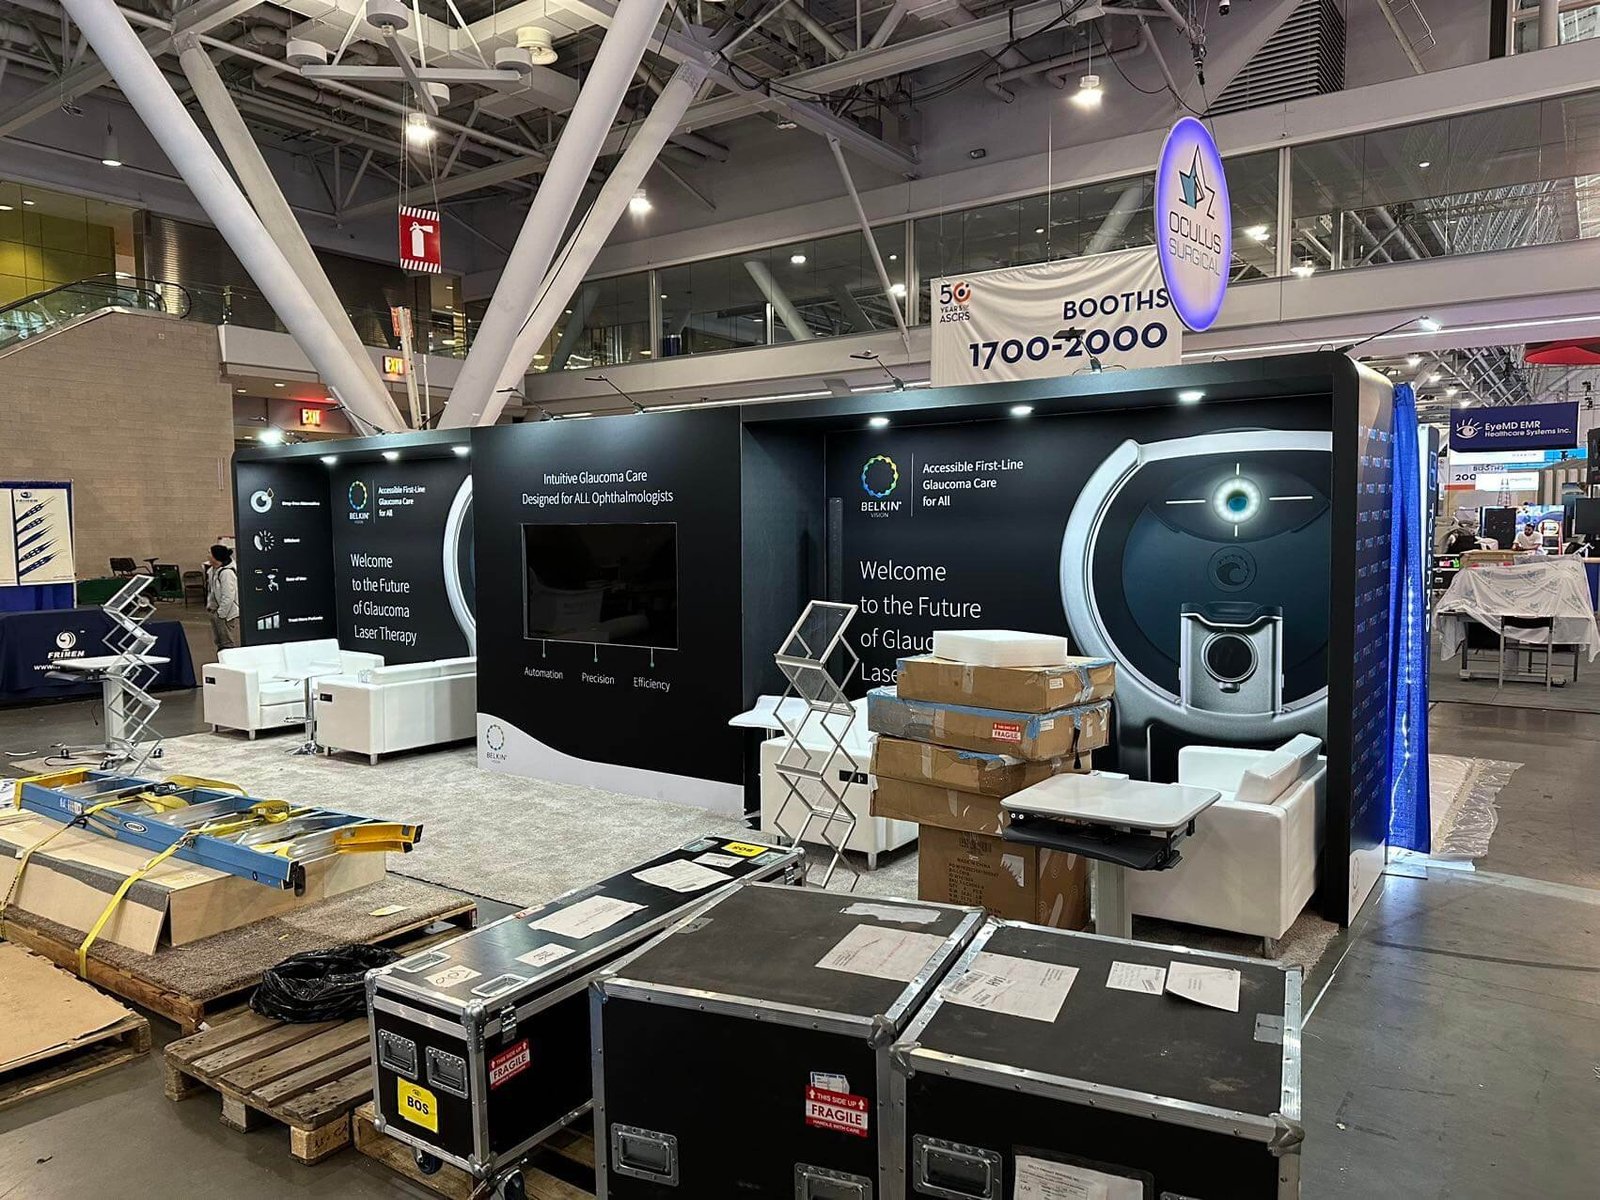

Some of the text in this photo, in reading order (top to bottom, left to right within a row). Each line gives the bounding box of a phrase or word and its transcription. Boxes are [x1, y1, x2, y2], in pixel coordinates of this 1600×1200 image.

[1169, 211, 1221, 255] OCULUS
[1169, 236, 1221, 277] SURGICAL
[1063, 288, 1169, 320] BOOTHS
[940, 311, 971, 323] ASCRS
[969, 322, 1168, 370] 1700-2000
[385, 356, 403, 374] EXIT
[302, 408, 320, 425] EXIT
[1484, 420, 1541, 431] EyeMD EMR
[1526, 428, 1556, 436] Systems
[922, 458, 1024, 474] Accessible First-Line
[543, 469, 648, 485] Intuitive Glaucoma Care
[922, 477, 997, 490] Glaucoma Care
[378, 484, 426, 494] Accessible First-Line
[378, 497, 414, 506] Glaucoma Care
[522, 490, 674, 508] Designed for ALL Ophthalmologists
[922, 495, 950, 507] for All
[378, 509, 386, 517] for
[350, 553, 393, 568] Welcome
[860, 560, 947, 581] Welcome
[352, 577, 410, 593] to the Future
[353, 601, 410, 618] of Glaucoma
[860, 594, 982, 618] to the Future
[354, 624, 417, 646] Laser Therapy
[860, 627, 879, 648] of
[524, 665, 563, 680] Automation
[581, 672, 615, 686] Precision
[861, 662, 898, 683] Lase
[633, 676, 671, 692] Efficiency
[994, 730, 1018, 739] FRAGILE
[493, 1052, 527, 1080] FRAGILE
[407, 1095, 429, 1115] BOS
[817, 1092, 857, 1107] THIS SIDE UP
[811, 1103, 862, 1126] FRAGILE
